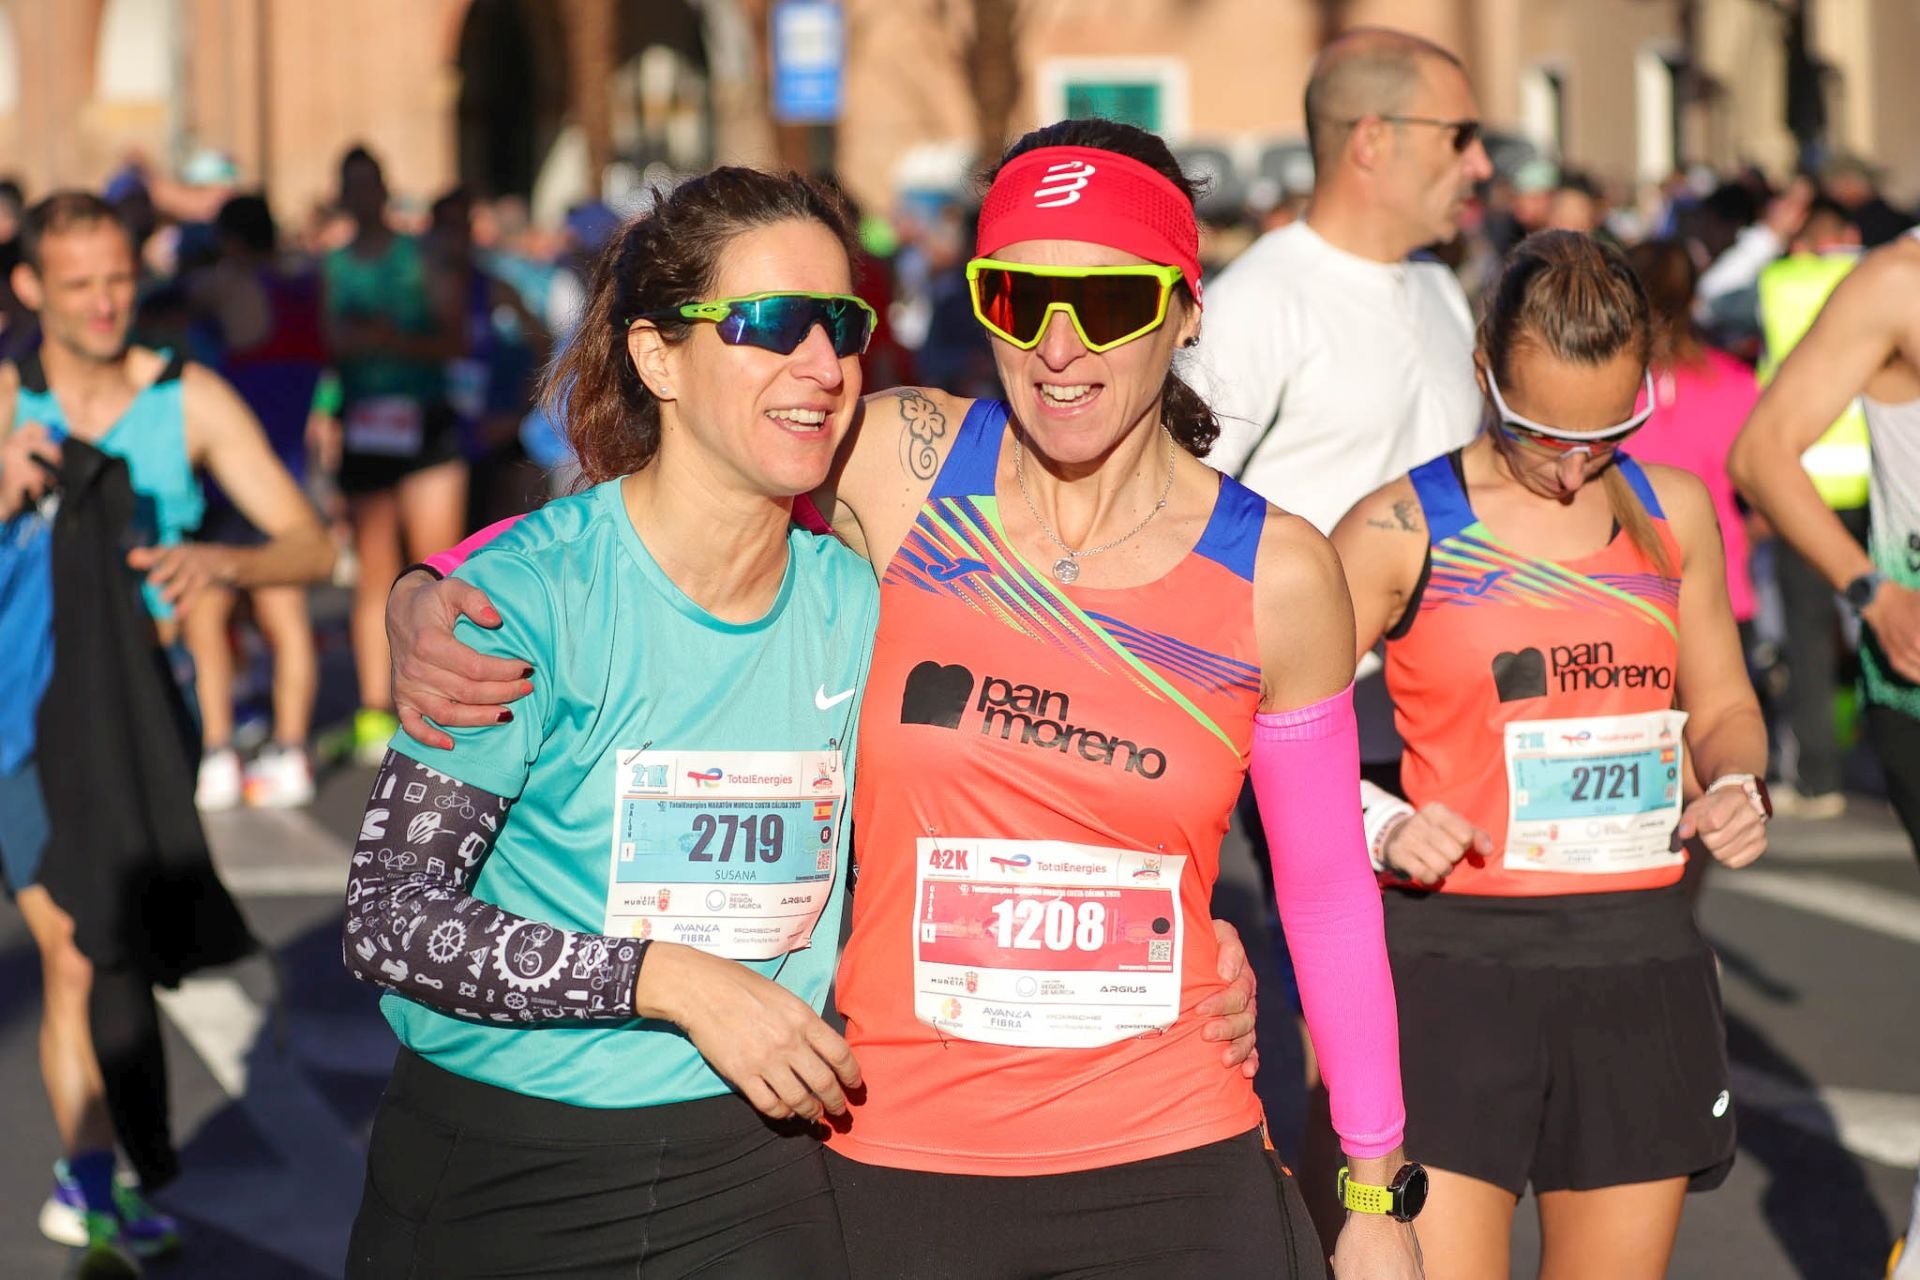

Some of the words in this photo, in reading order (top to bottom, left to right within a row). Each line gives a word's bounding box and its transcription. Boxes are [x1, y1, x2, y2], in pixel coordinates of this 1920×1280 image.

[1550, 641, 1613, 677] pan
[1560, 664, 1671, 692] moreno
[977, 676, 1069, 721] pan
[981, 706, 1167, 780] moreno
[632, 764, 669, 788] 21K
[727, 774, 793, 787] TotalEnergies
[1571, 763, 1640, 802] 2721
[669, 801, 707, 809] TotalEnergies
[688, 813, 784, 863] 2719
[929, 849, 969, 871] 42K
[715, 869, 757, 880] SUSANA
[1037, 861, 1107, 875] TotalEnergies
[781, 895, 812, 905] ARGIUS
[673, 923, 720, 932] AVANZA
[992, 898, 1106, 952] 1208
[681, 934, 711, 942] FIBRA
[1100, 985, 1147, 994] ARGIUS
[982, 1007, 1032, 1019] AVANZA
[990, 1018, 1022, 1028] FIBRA
